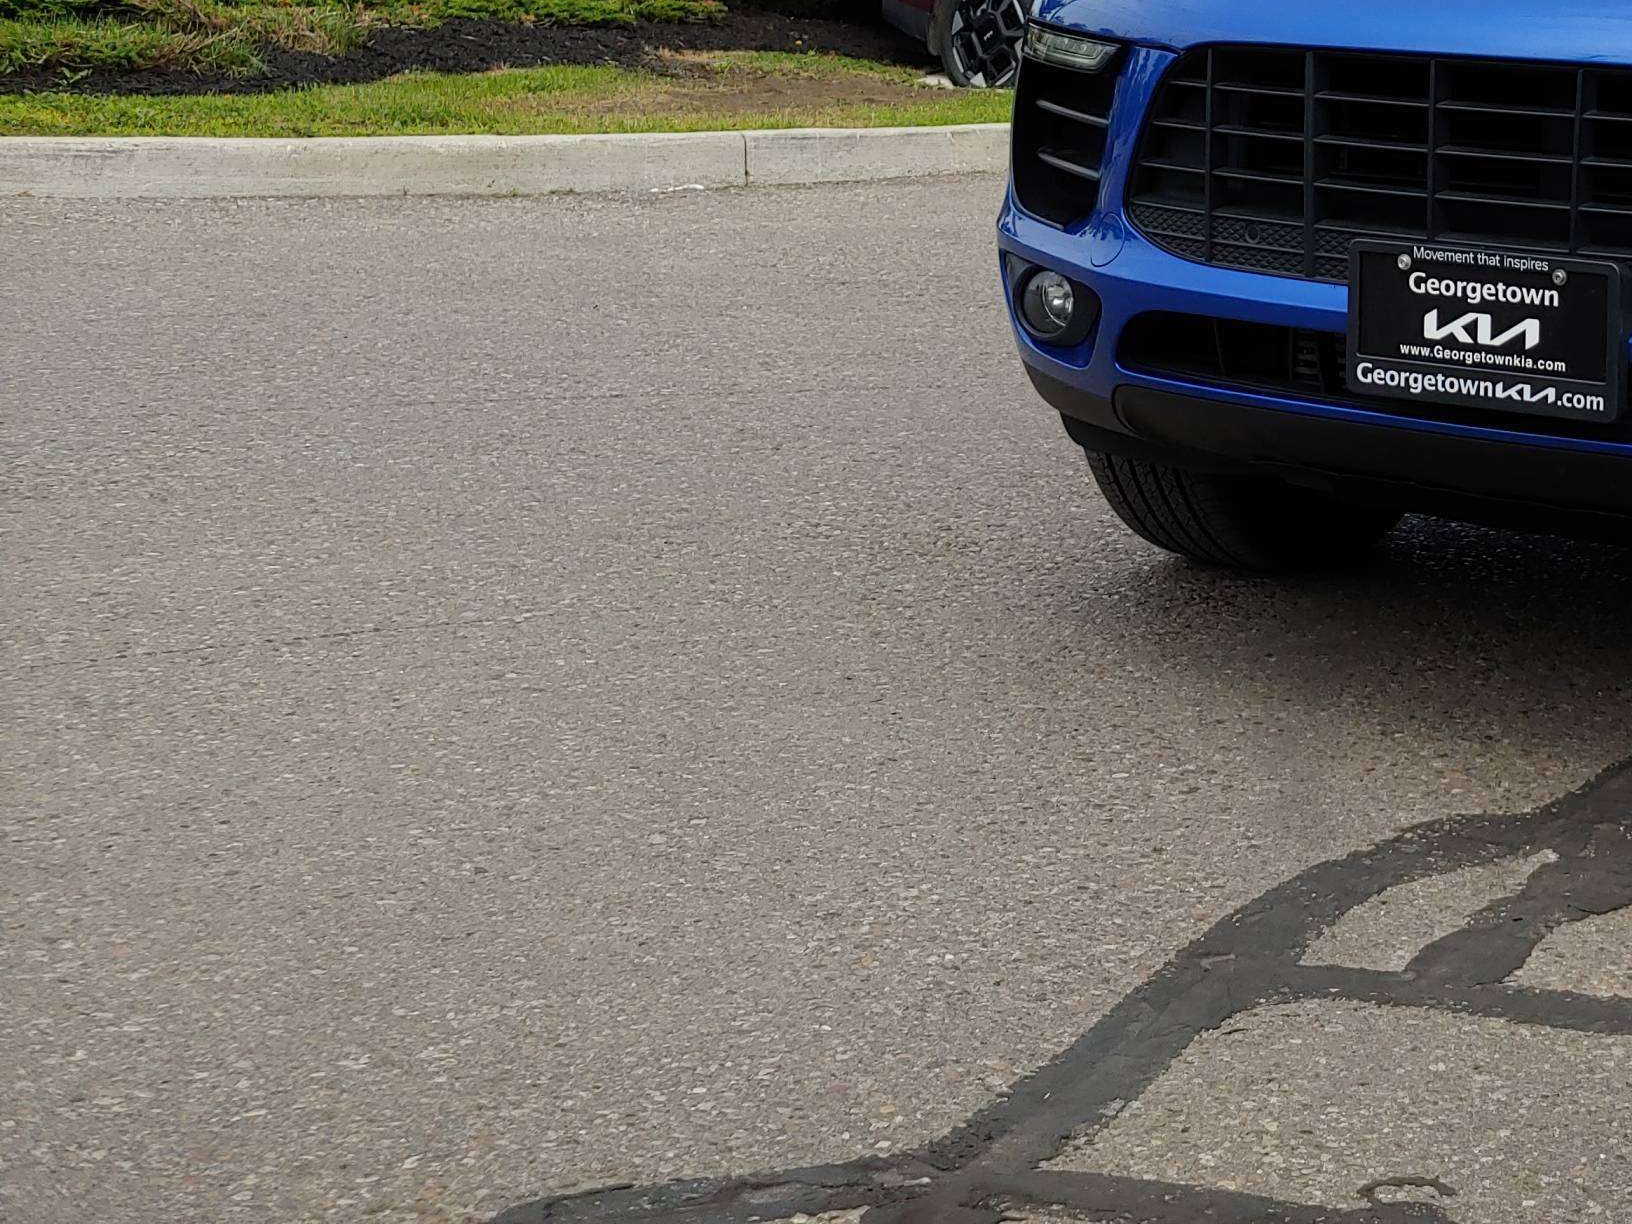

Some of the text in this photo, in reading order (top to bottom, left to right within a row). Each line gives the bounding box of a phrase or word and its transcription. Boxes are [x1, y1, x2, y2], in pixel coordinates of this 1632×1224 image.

[1413, 246, 1549, 271] Movement that inspires
[1408, 271, 1559, 307] Georgetown
[1424, 308, 1540, 350] KIA
[1400, 343, 1566, 372] www.Georgetownkia.com
